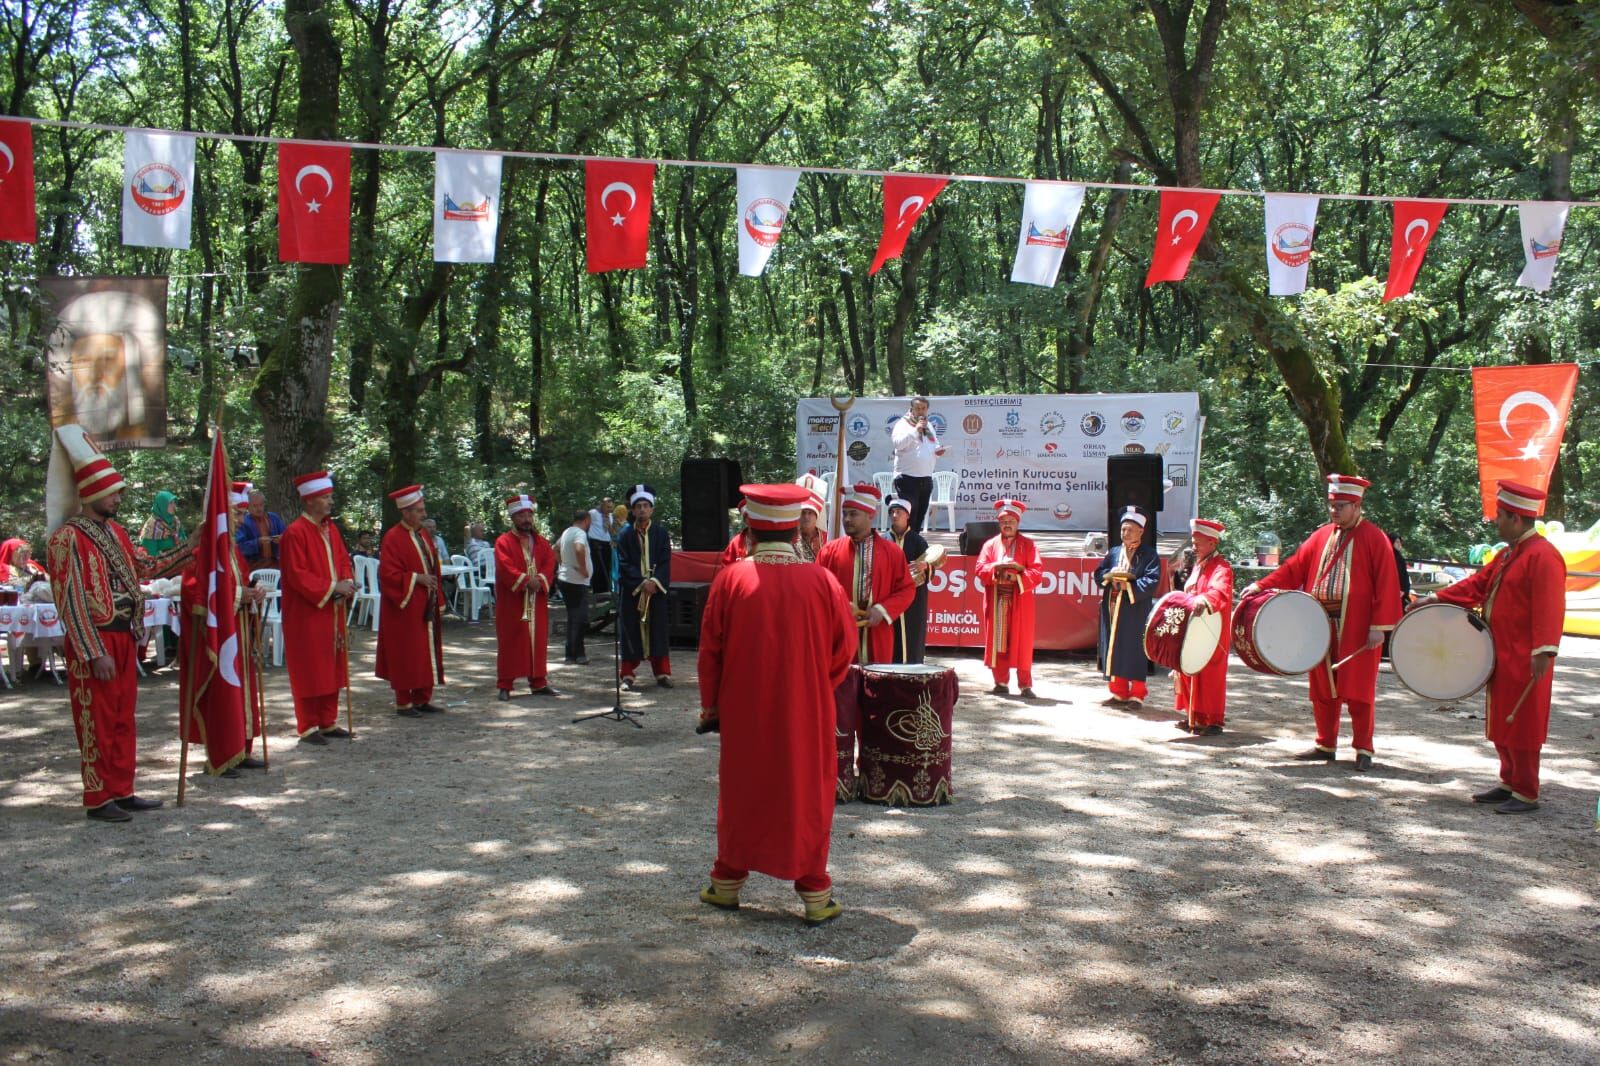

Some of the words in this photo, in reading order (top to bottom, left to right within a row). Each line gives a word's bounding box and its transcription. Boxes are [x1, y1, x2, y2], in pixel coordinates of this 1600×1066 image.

[964, 398, 1023, 407] DESTEKÇİLERİMİZ
[1006, 445, 1031, 458] pelin
[961, 468, 1018, 479] Devletinin
[1023, 468, 1077, 479] Kurucusu
[958, 480, 993, 491] Anma
[996, 482, 1011, 491] ve
[1015, 480, 1062, 491] Tanıtma
[1065, 480, 1108, 493] Şenlikl
[928, 569, 967, 598] OŞ
[935, 609, 980, 625] BİNGÖL
[941, 626, 980, 636] BAŞKANI
